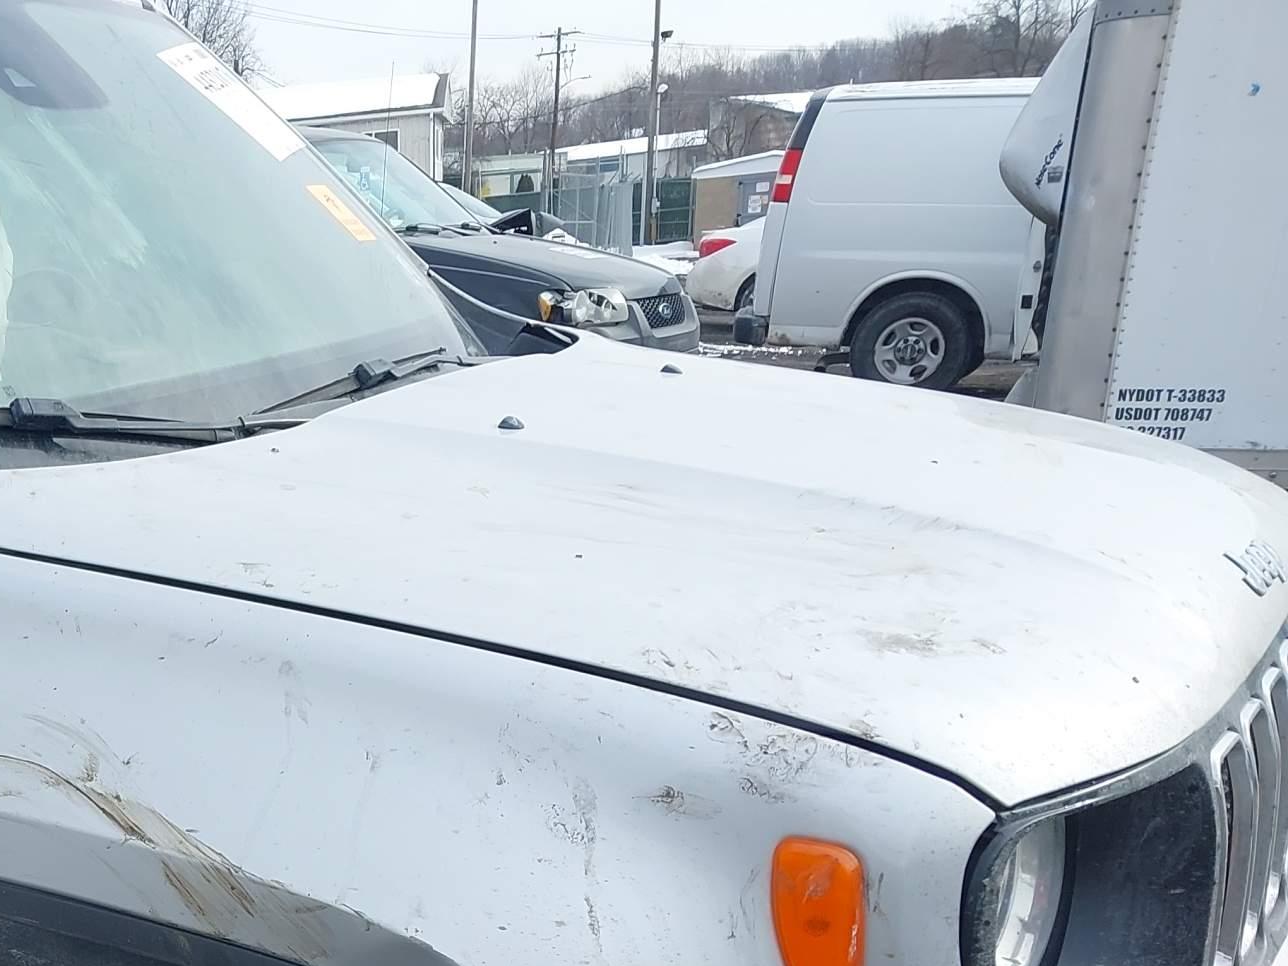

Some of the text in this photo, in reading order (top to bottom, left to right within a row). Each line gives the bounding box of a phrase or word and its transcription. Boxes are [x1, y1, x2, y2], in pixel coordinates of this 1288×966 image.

[1117, 388, 1226, 403] NYDOT T-33833
[1115, 407, 1213, 422] USDOT 708747
